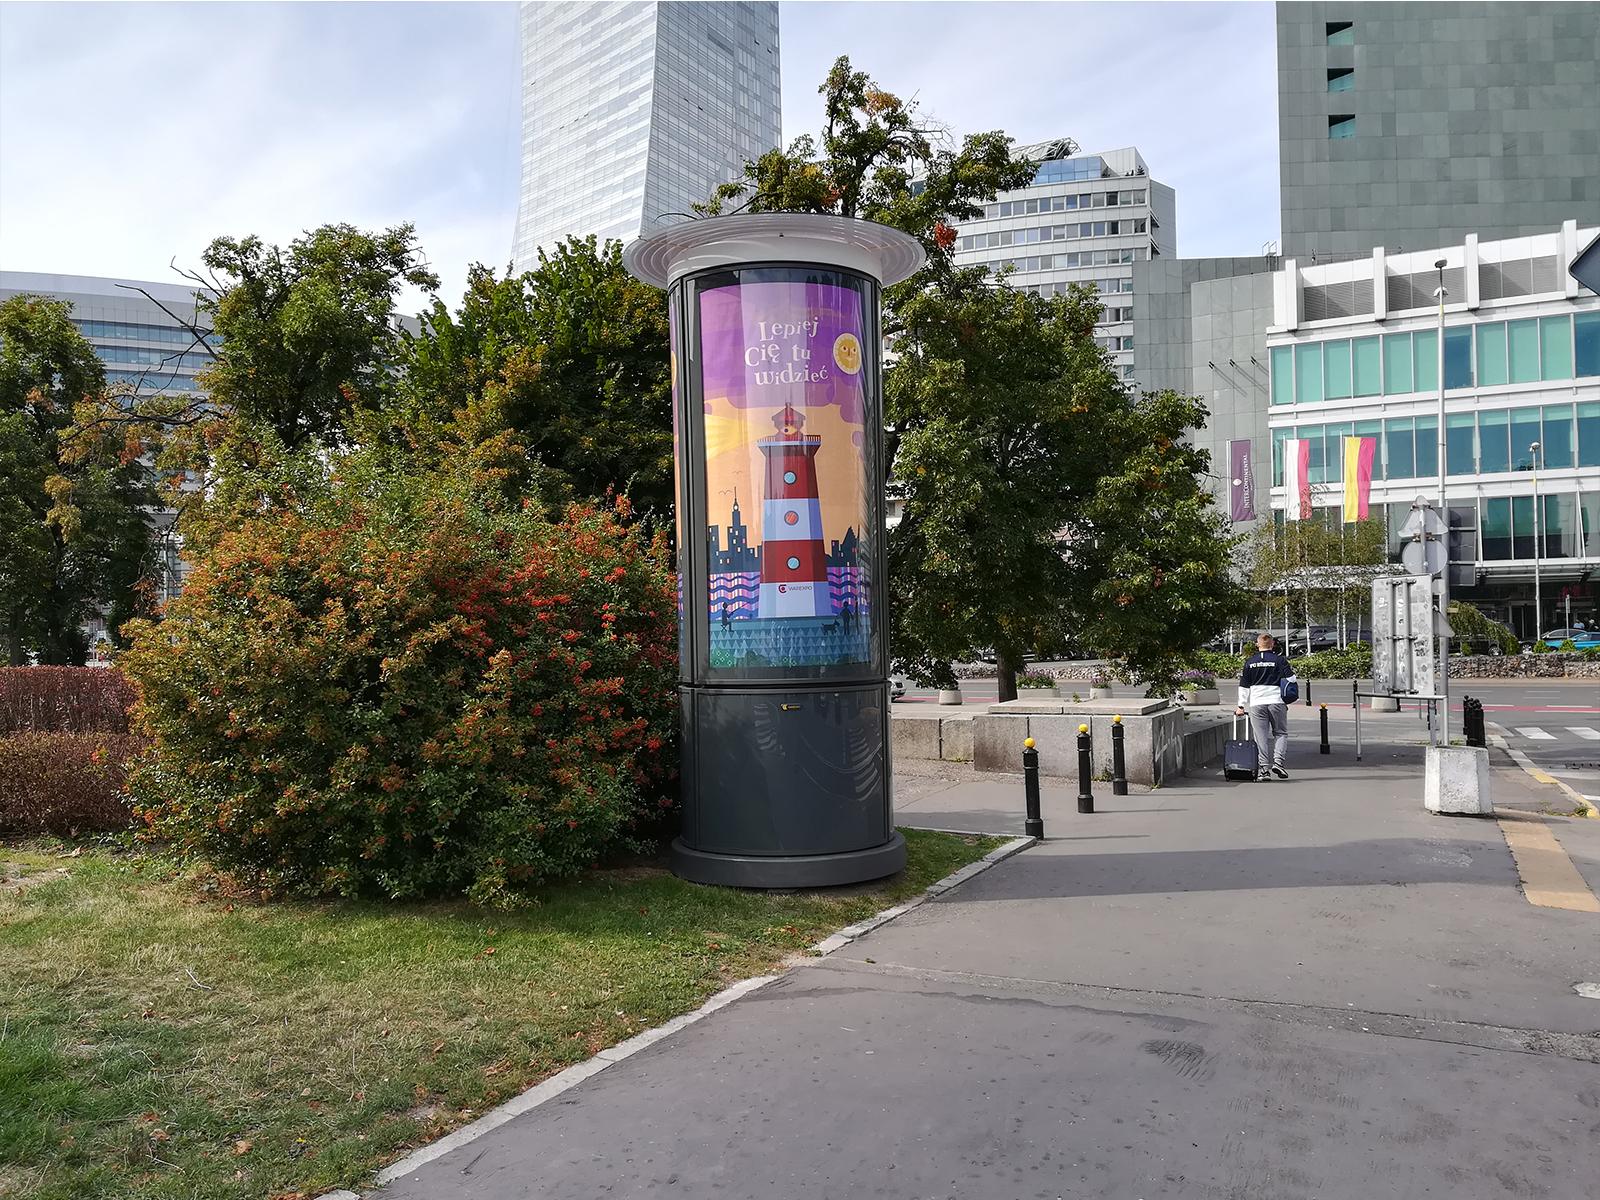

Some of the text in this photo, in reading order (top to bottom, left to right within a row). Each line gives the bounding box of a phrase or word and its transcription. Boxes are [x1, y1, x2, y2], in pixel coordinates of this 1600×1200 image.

[758, 316, 819, 342] Lepiej
[744, 343, 811, 367] Cię tu
[754, 362, 829, 386] widzieć
